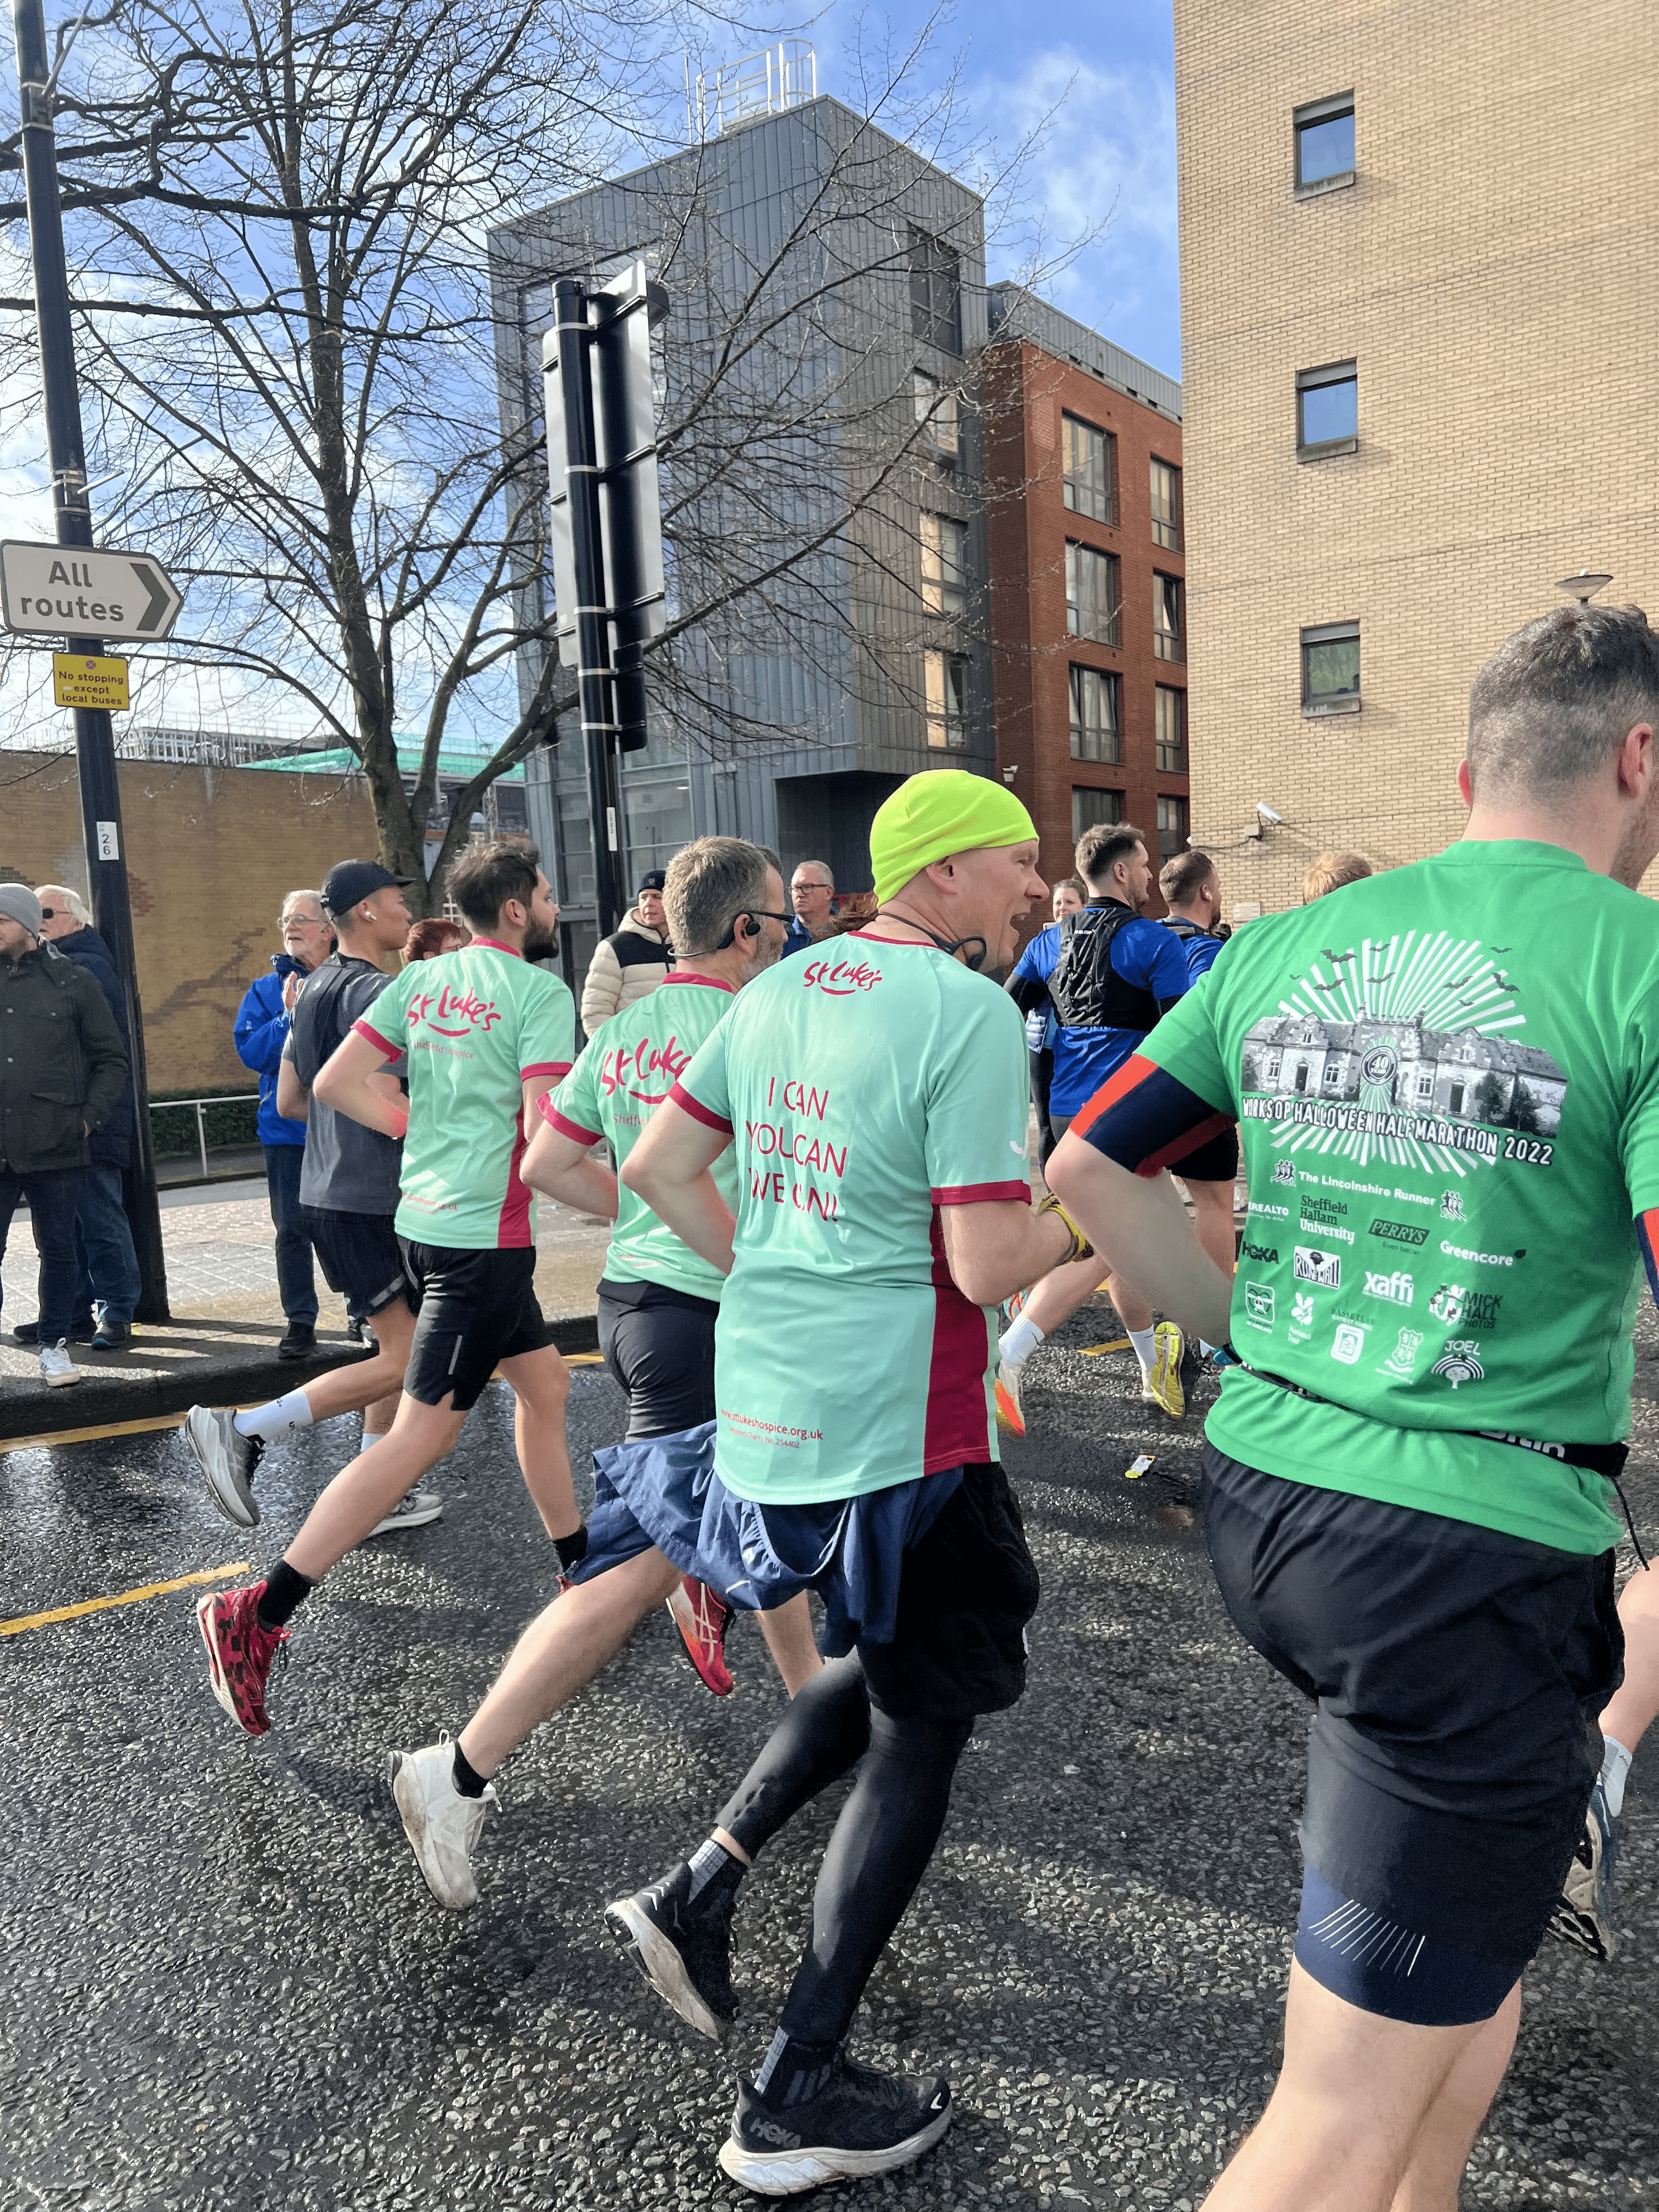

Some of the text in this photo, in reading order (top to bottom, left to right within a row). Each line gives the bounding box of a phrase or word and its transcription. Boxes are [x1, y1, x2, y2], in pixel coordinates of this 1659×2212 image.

[49, 561, 92, 588] All
[21, 596, 124, 622] routes
[59, 671, 123, 685] No stopping
[74, 686, 110, 695] except
[62, 693, 122, 705] local buses
[803, 961, 883, 991] St Luke's
[407, 985, 501, 1031] St Luke's
[1372, 1056, 1389, 1069] 40
[768, 1076, 829, 1121] I CAN
[1242, 1097, 1555, 1166] WORKSOP HALLOWEEN HALF MARATHON 2022
[794, 1134, 847, 1178] CAN
[748, 1167, 784, 1204] WE
[1299, 1171, 1437, 1206] The Lincolnshire Runner
[1300, 1207, 1338, 1225] Hallam
[1301, 1195, 1347, 1215] Sheffield
[1300, 1217, 1356, 1245] University
[1372, 1221, 1426, 1243] PERRYS
[1383, 1241, 1398, 1250] Even
[1440, 1240, 1514, 1266] Greencore
[1363, 1271, 1414, 1304] xaffi
[1444, 1340, 1480, 1356] JOEL
